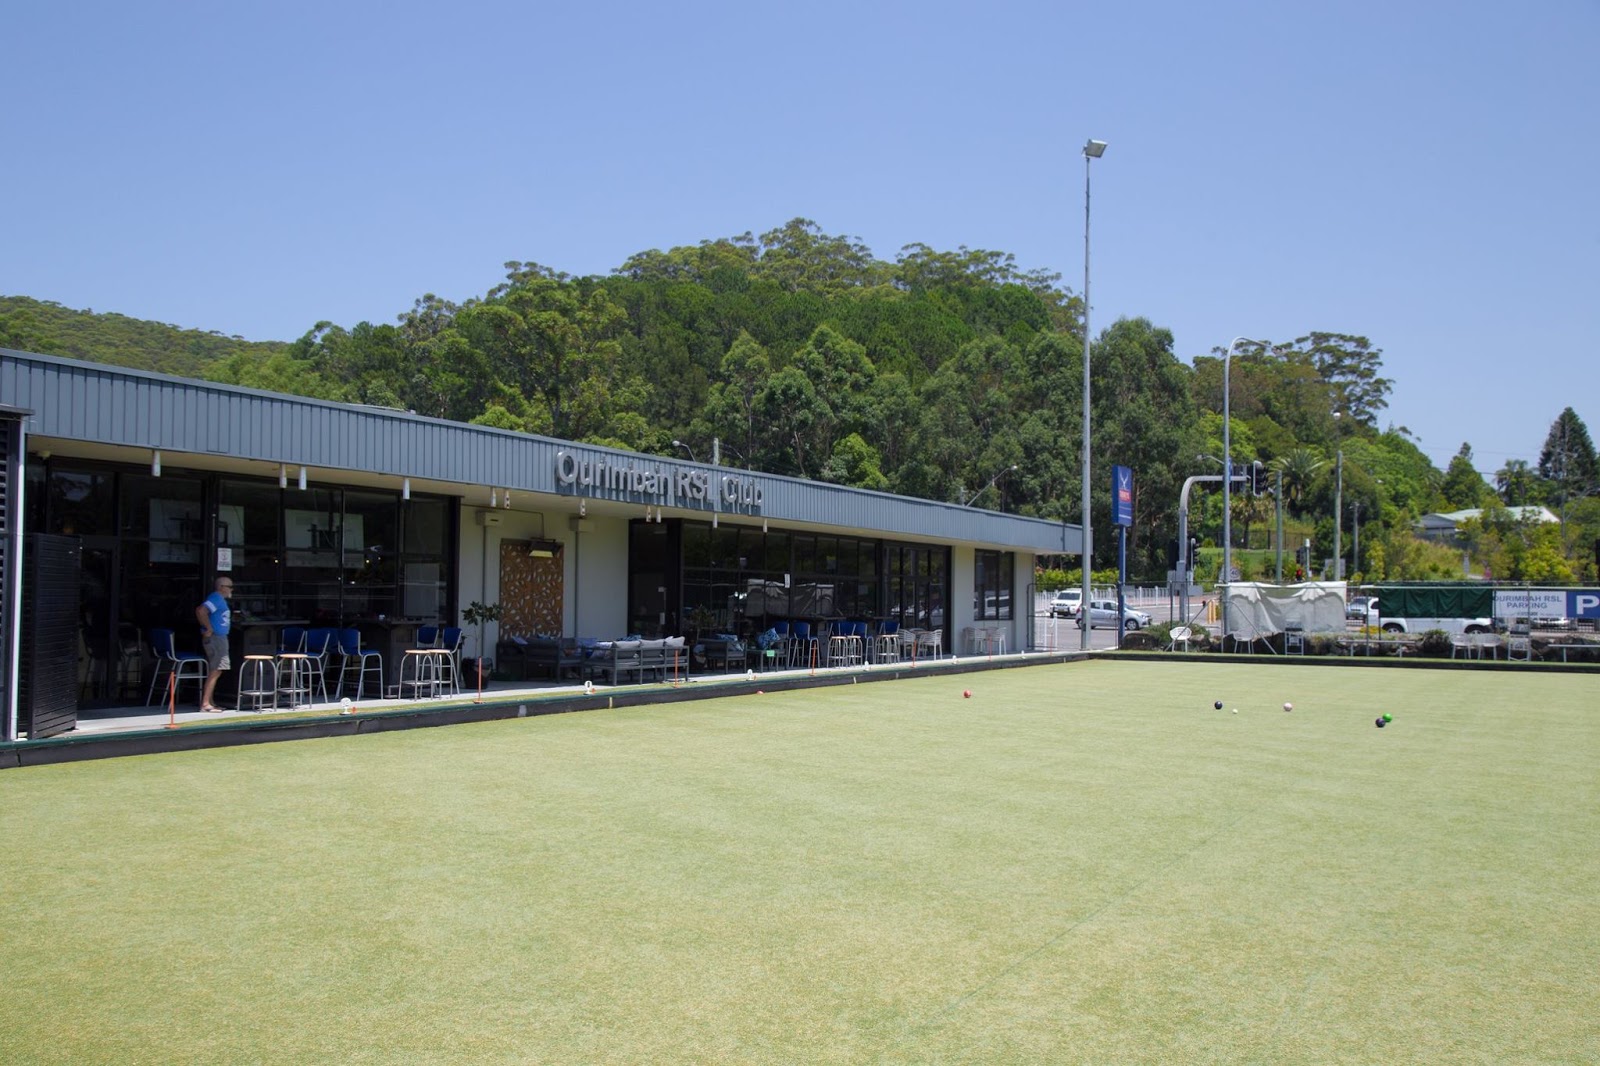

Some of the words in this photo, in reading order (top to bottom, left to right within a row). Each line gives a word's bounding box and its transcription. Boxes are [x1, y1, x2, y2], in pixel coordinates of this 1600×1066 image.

[676, 466, 718, 500] RSL
[721, 475, 763, 506] Club
[1576, 595, 1600, 615] P
